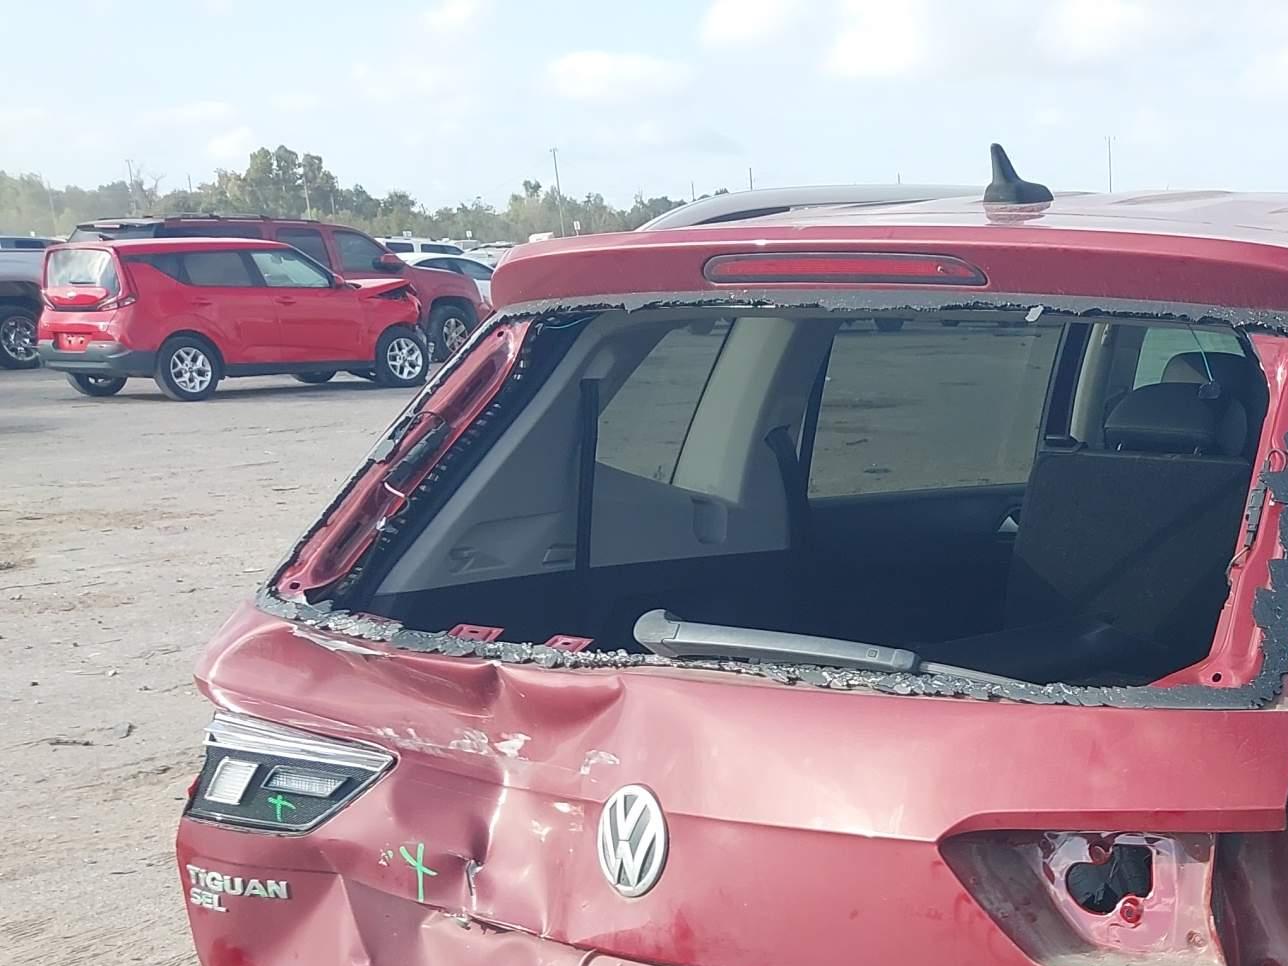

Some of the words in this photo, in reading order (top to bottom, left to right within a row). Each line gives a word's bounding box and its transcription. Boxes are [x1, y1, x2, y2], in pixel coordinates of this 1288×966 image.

[597, 784, 668, 897] VW
[186, 864, 289, 899] TIGUAN
[190, 887, 229, 912] SEL
